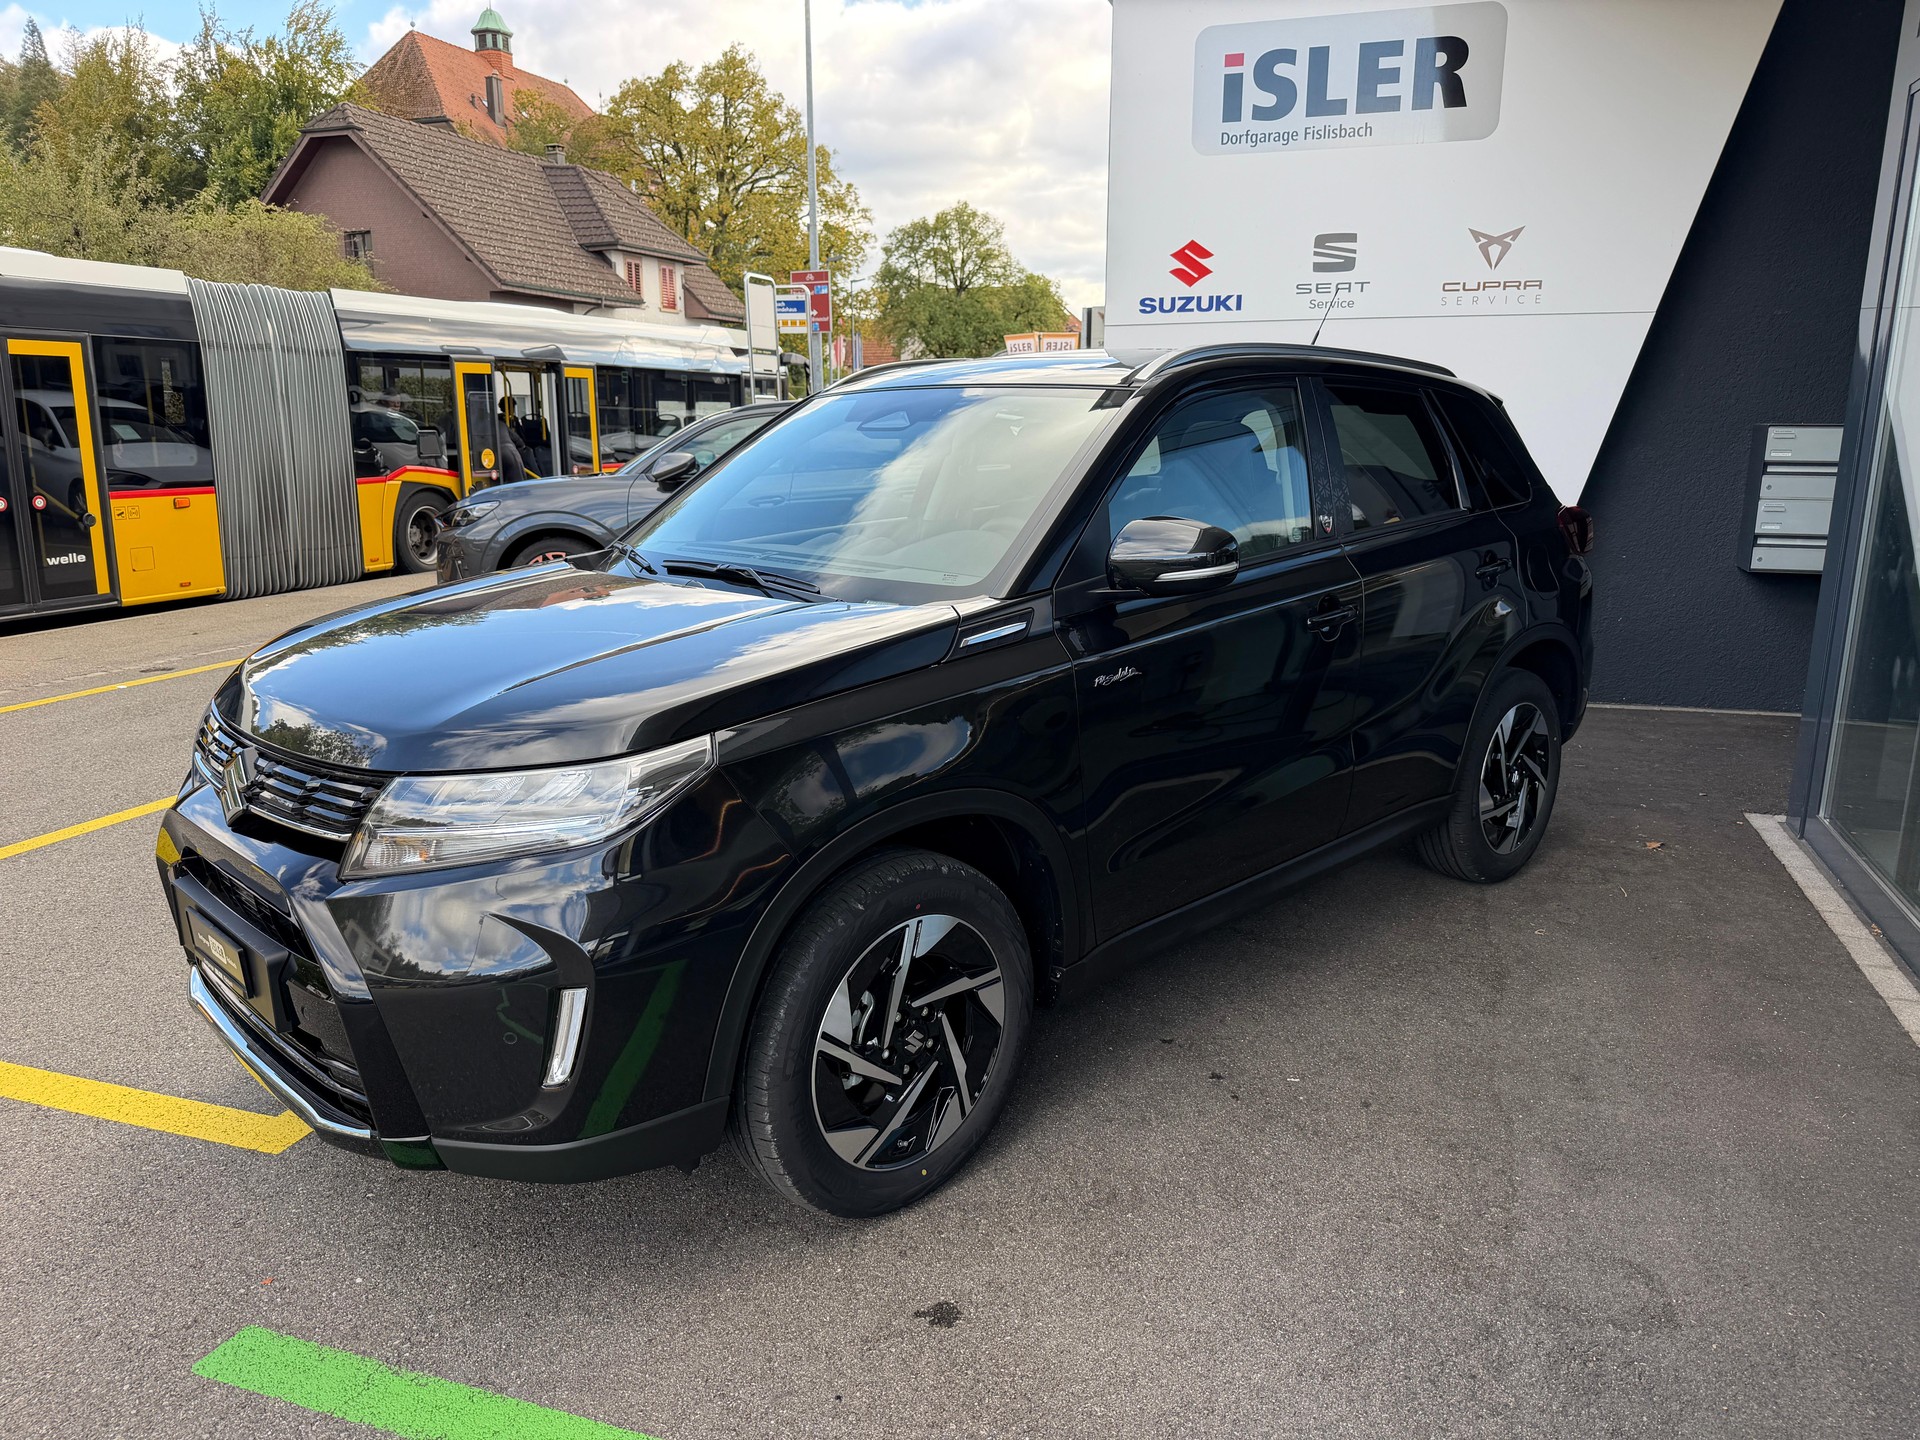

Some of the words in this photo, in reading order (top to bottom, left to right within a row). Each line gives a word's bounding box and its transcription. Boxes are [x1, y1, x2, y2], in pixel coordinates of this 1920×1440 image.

[1221, 35, 1470, 123] iSLER
[1220, 129, 1299, 148] Dorfgarage
[1303, 122, 1373, 141] Fislisbach
[1295, 281, 1371, 294] SEAT
[1441, 279, 1543, 292] CUPRA
[1139, 294, 1243, 314] SUZUKI
[1308, 298, 1355, 309] Service
[1440, 294, 1542, 306] SERVICE
[46, 552, 87, 566] welle
